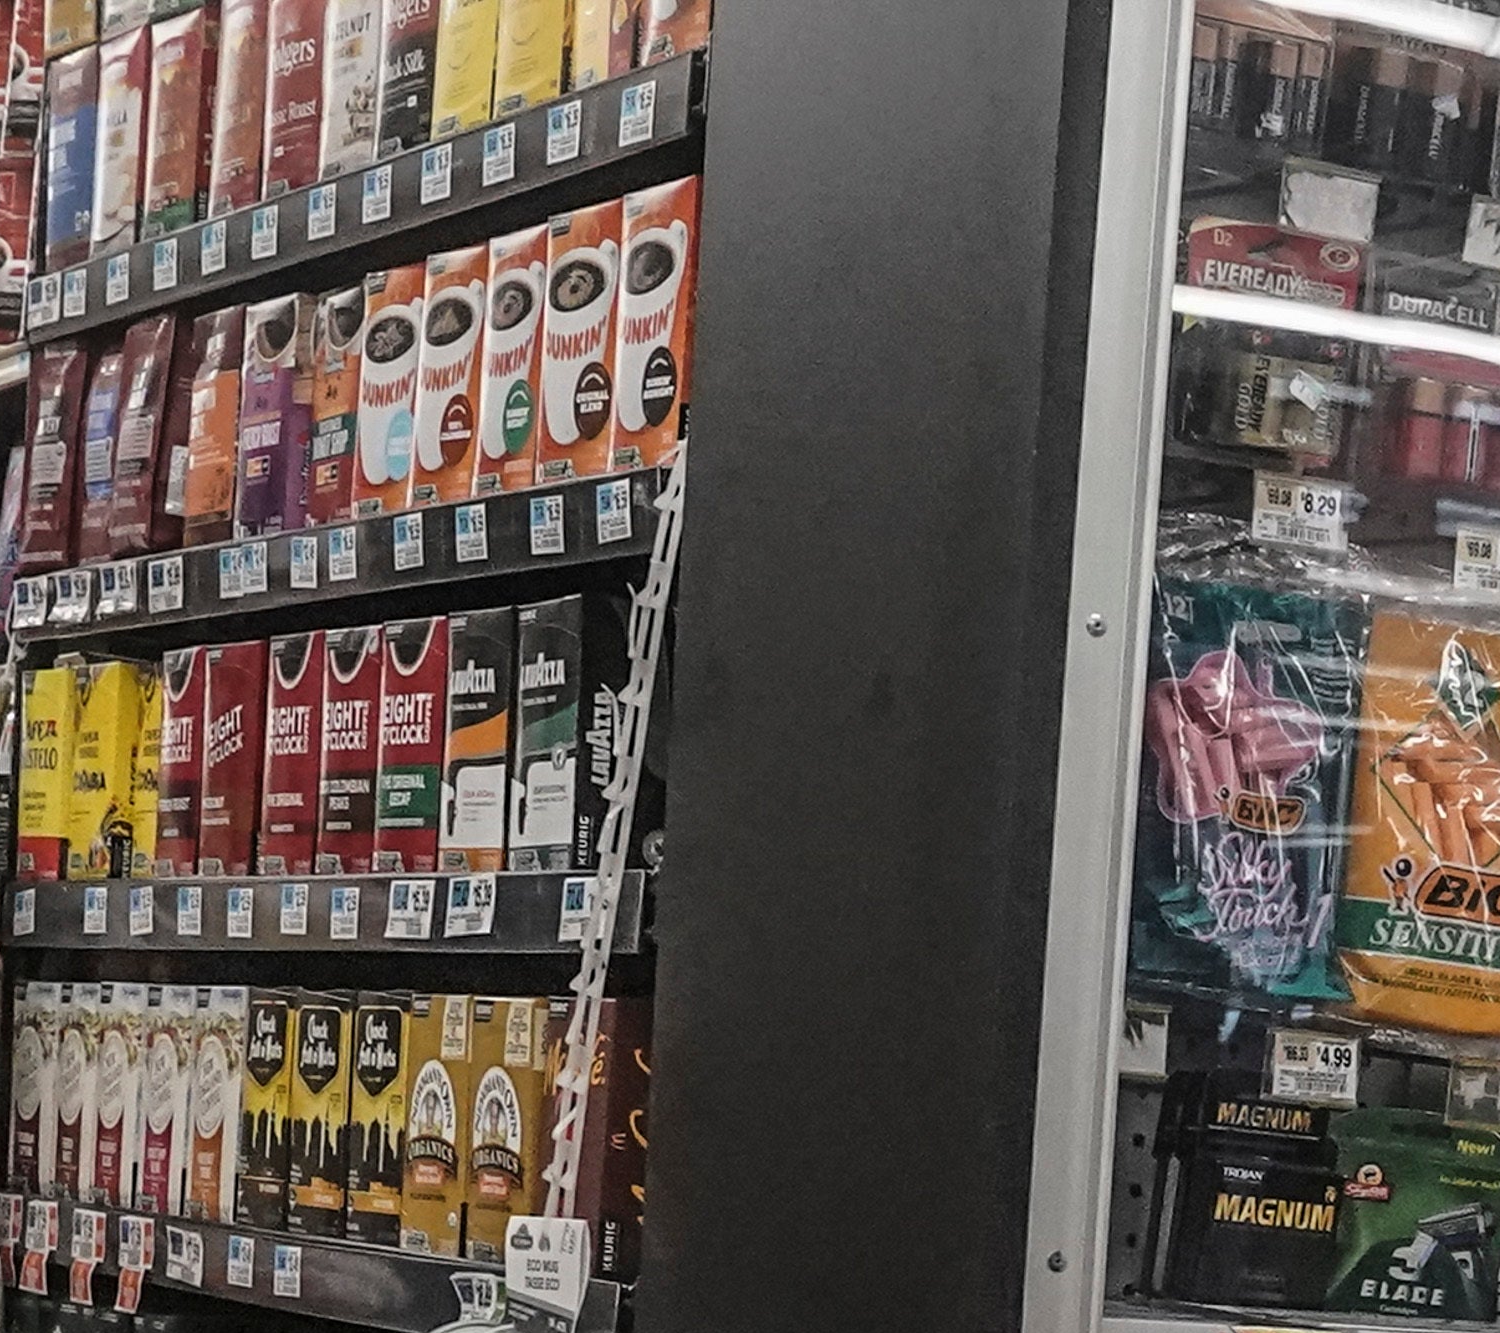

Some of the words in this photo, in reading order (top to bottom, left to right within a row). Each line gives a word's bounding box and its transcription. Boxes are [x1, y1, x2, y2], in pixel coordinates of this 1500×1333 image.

[1203, 258, 1298, 298] EVEREADY
[1388, 291, 1490, 329] DURACELL
[1300, 490, 1337, 517] $8.29
[384, 693, 426, 725] EIGHT
[577, 814, 592, 868] KEURIG
[1200, 832, 1292, 893] Silky
[1316, 1044, 1352, 1068] $4.99
[1217, 1103, 1311, 1132] MAGNUM
[1456, 1137, 1496, 1156] New!
[1223, 1167, 1265, 1182] TROJAN
[1214, 1192, 1335, 1232] MAGNUM
[602, 1219, 616, 1272] KEURIG
